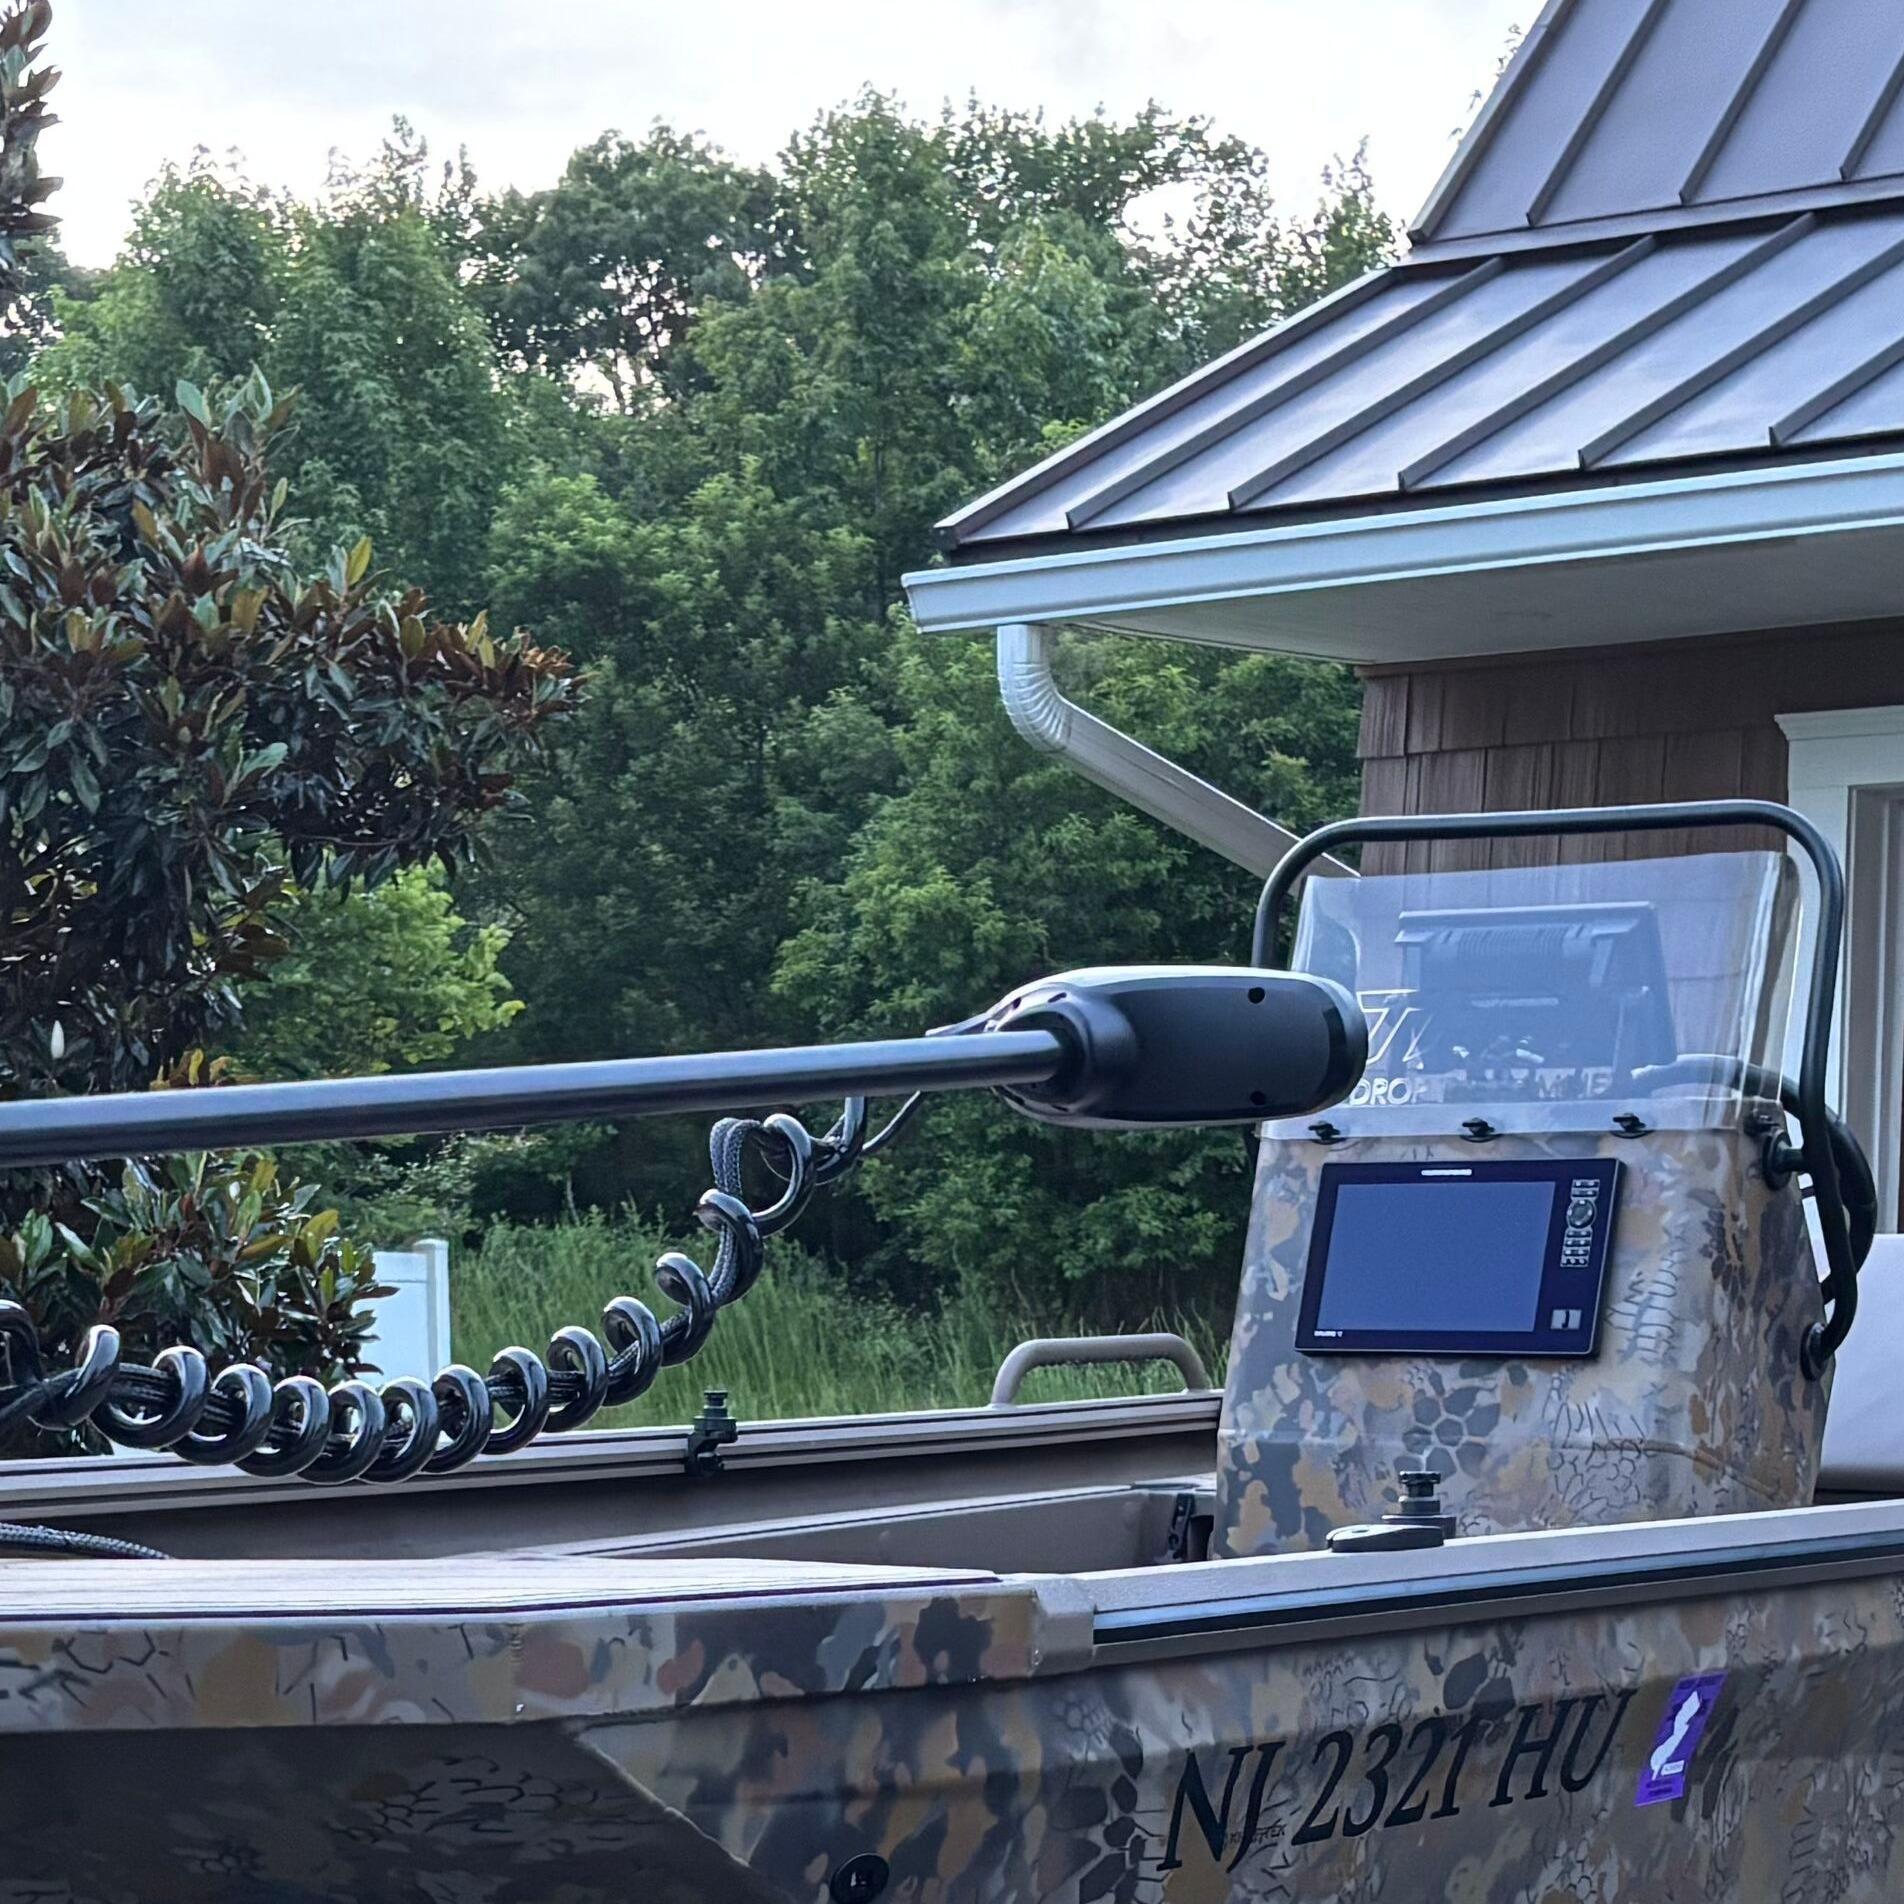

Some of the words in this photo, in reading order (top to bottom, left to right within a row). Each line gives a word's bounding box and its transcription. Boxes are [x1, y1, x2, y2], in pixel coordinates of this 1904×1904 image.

[1156, 1740, 1287, 1873] NJ
[1291, 1712, 1483, 1846] 2321
[1488, 1688, 1639, 1807] HU
